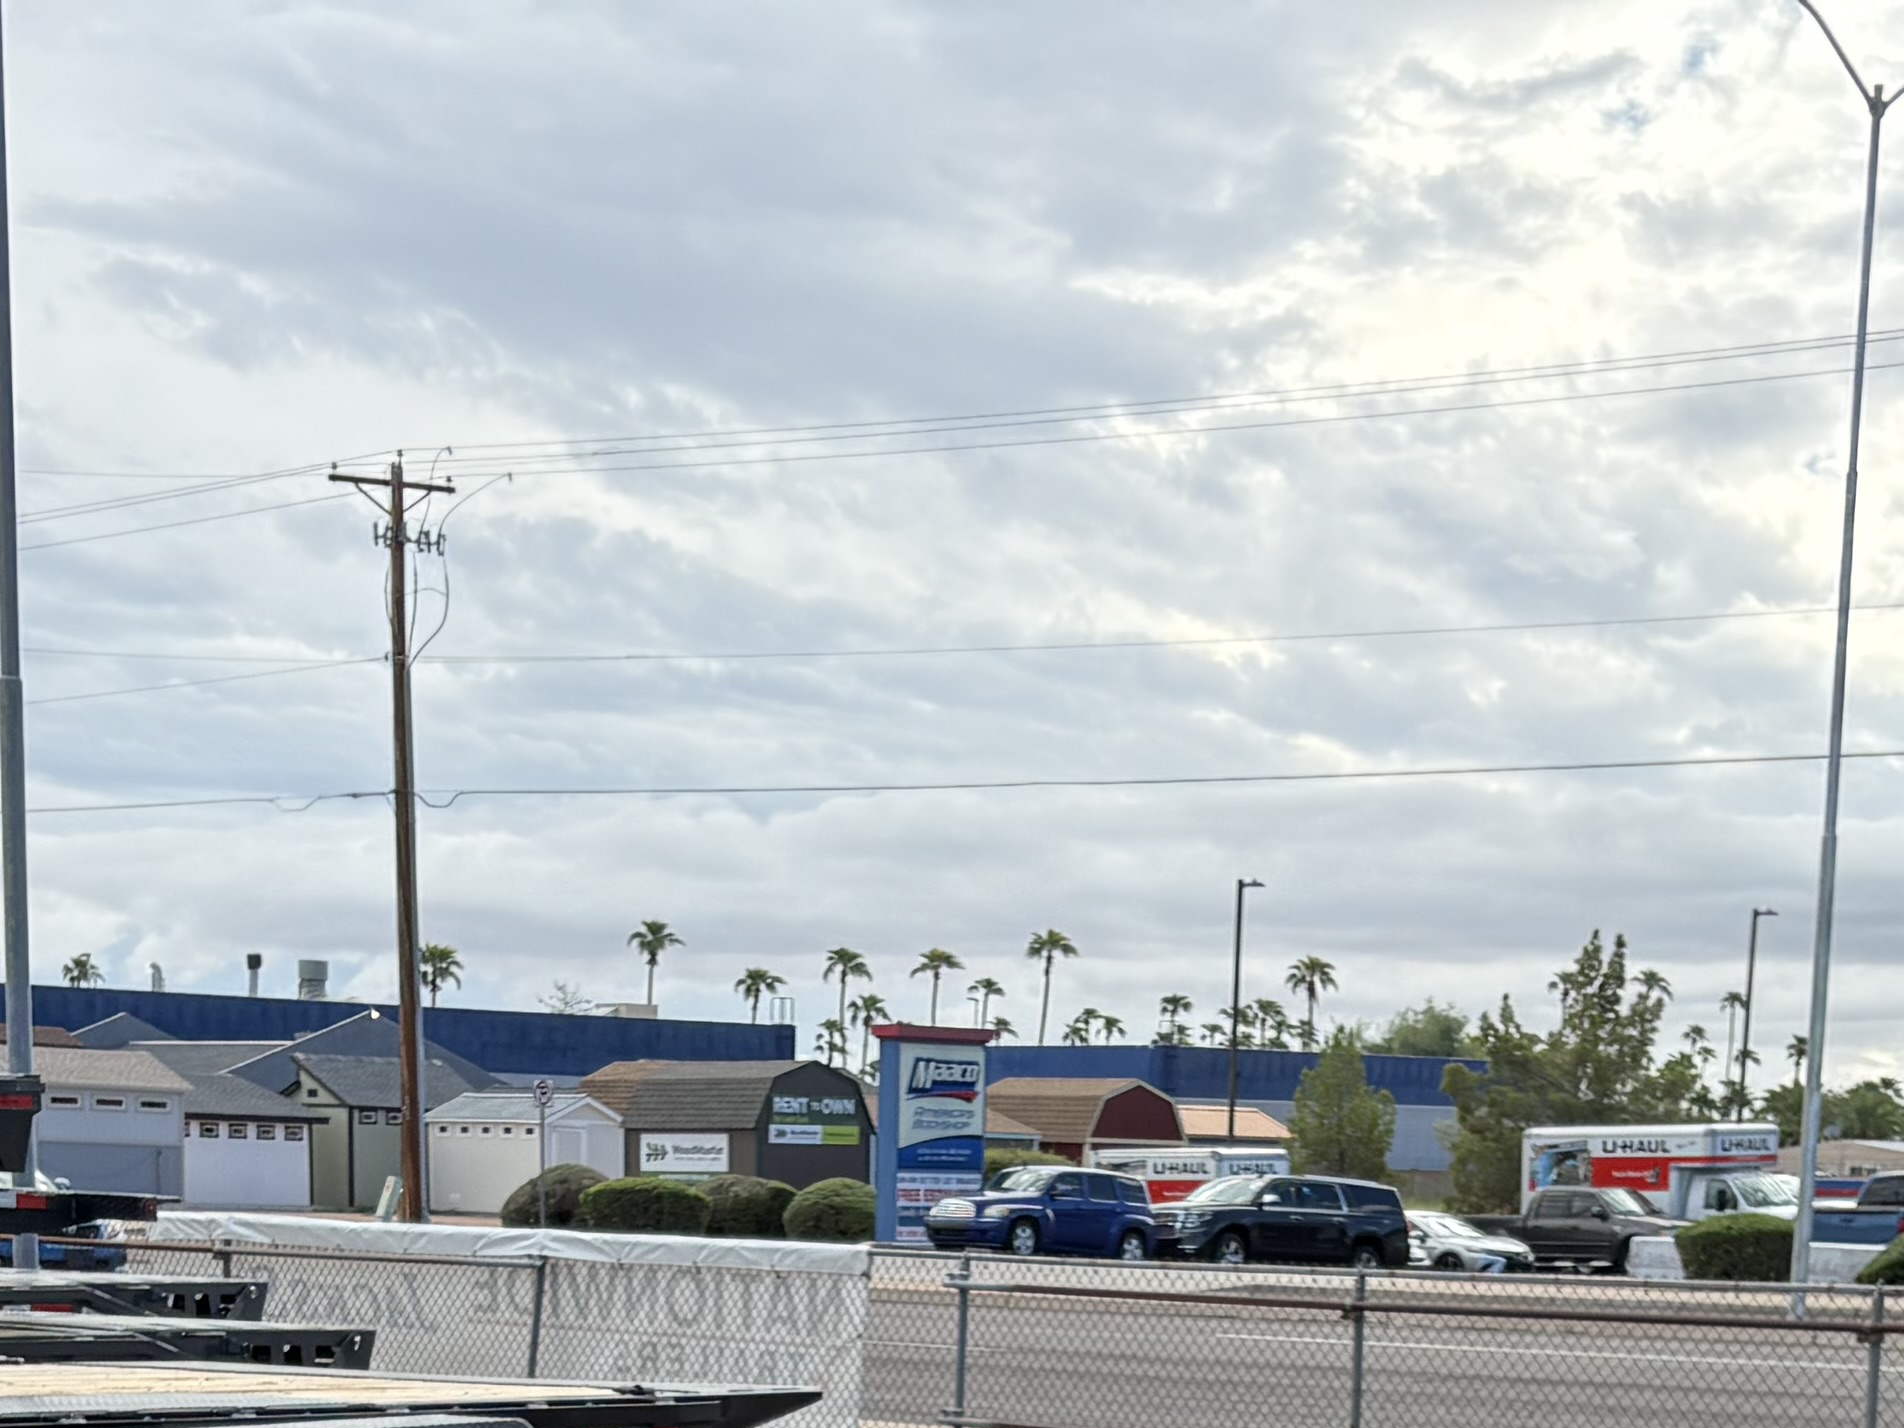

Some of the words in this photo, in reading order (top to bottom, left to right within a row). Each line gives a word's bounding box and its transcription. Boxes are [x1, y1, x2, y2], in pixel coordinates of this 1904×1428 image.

[1602, 1140, 1671, 1153] U-HAUL
[1721, 1138, 1772, 1152] U-HAUL
[1153, 1162, 1210, 1175] U-HAUL
